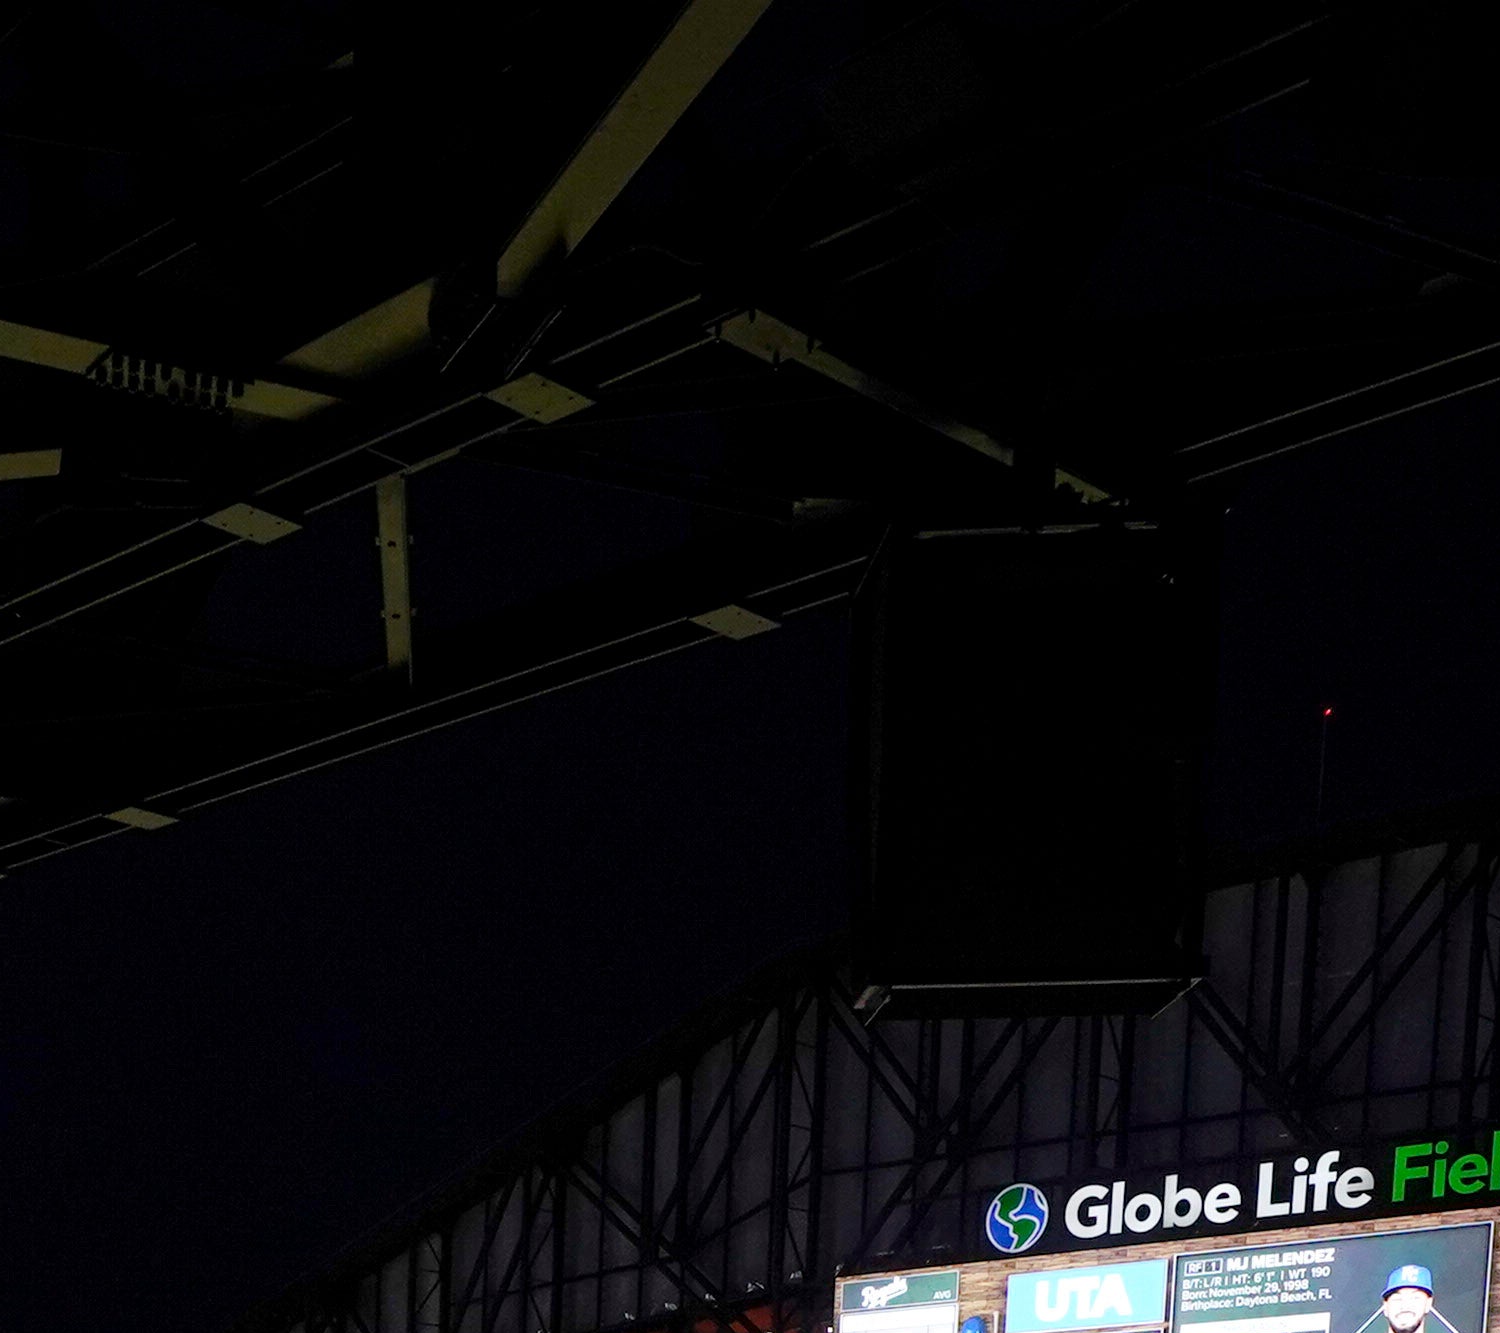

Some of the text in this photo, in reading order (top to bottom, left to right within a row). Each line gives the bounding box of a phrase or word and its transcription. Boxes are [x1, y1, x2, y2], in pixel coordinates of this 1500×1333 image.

[1065, 1174, 1241, 1239] Globe
[1256, 1151, 1375, 1218] Life
[1226, 1248, 1335, 1272] MJ MELENDEZ
[1035, 1274, 1133, 1322] UTA
